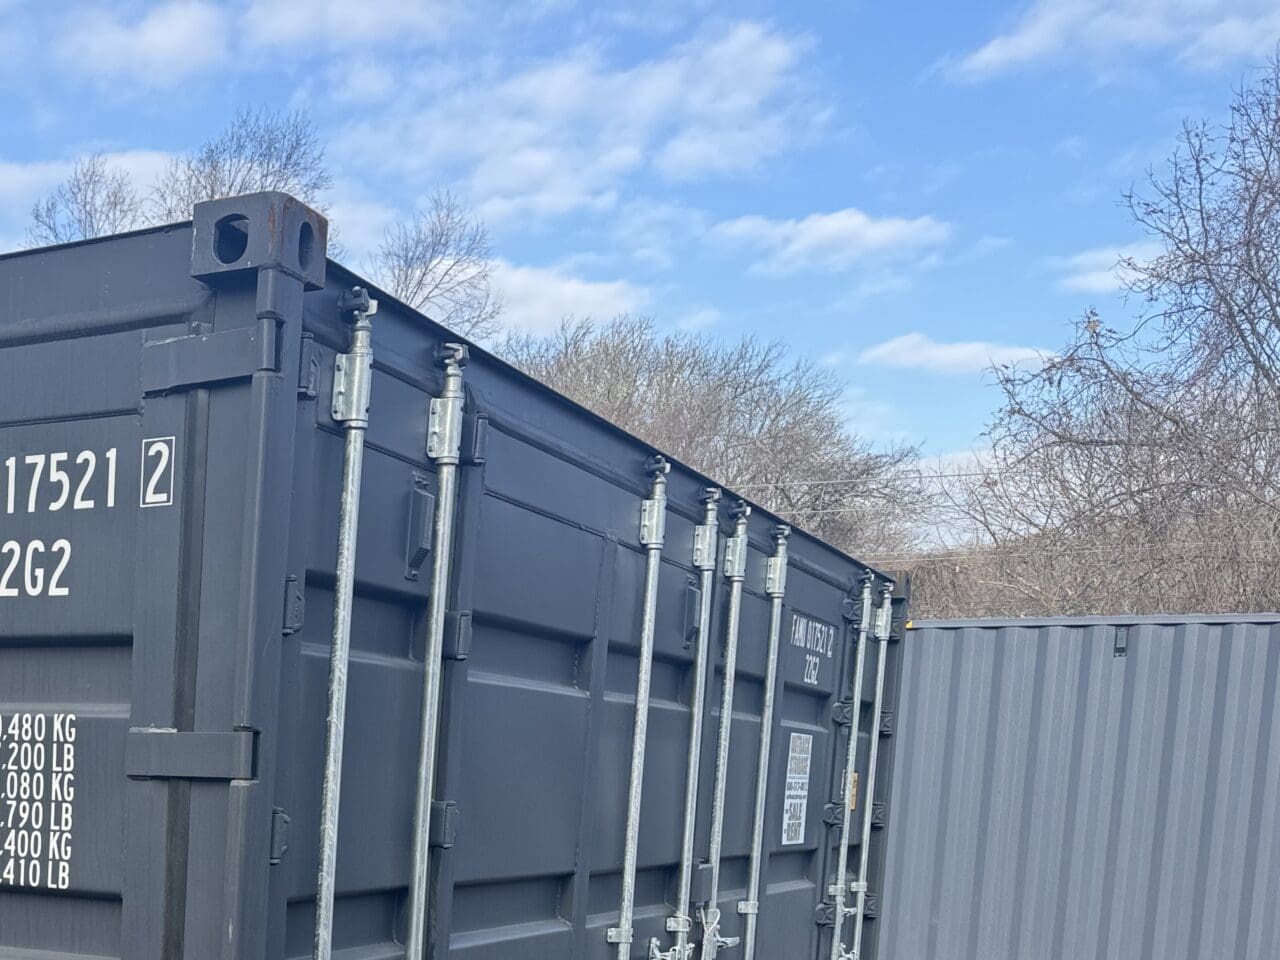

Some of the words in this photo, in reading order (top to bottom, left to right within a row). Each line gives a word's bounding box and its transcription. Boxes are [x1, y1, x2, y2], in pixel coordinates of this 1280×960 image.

[145, 441, 169, 503] 2
[52, 714, 76, 742] KG
[51, 743, 75, 772] LB
[51, 773, 75, 801] KG
[50, 802, 73, 831] LB
[48, 832, 72, 860] KG
[46, 861, 70, 890] LB
